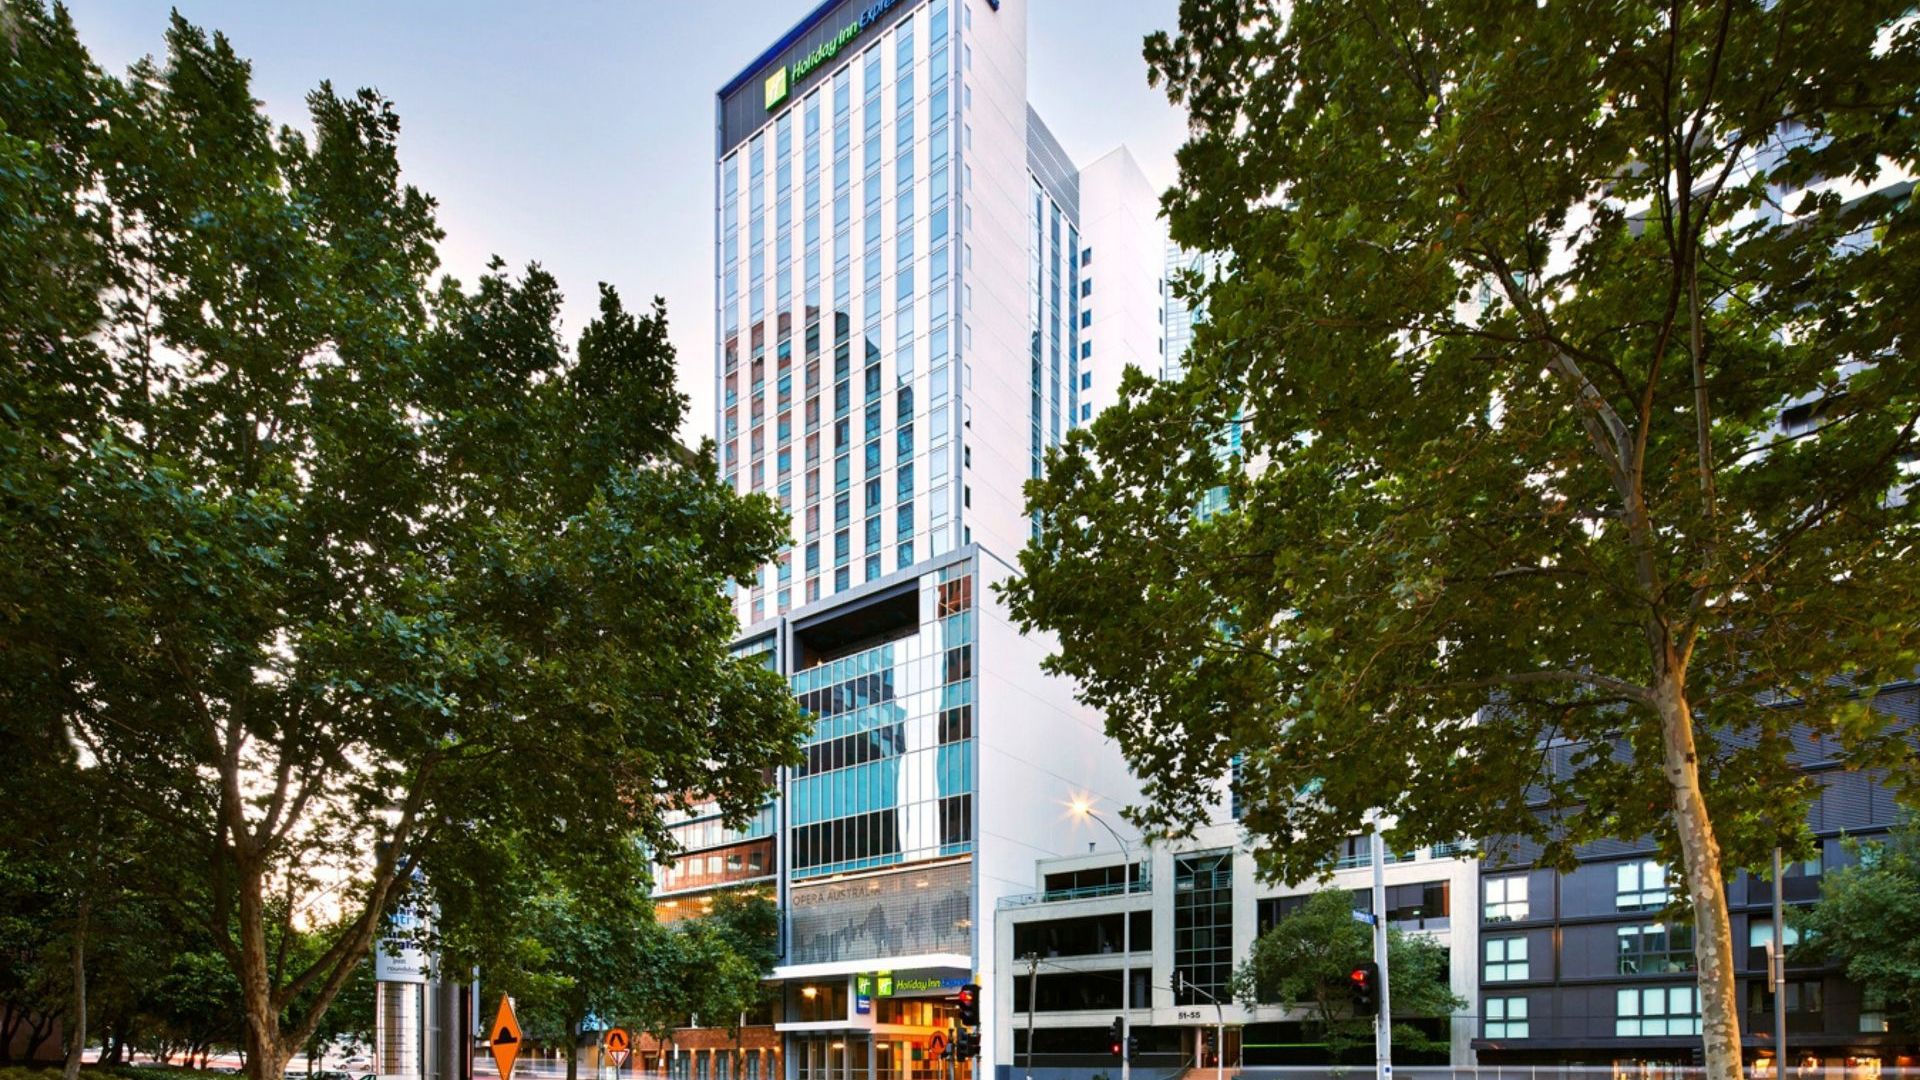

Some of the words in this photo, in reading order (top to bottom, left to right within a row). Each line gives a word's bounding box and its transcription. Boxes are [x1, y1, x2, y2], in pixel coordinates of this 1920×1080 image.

[791, 37, 837, 81] Holiday
[838, 21, 858, 45] Inn
[792, 892, 824, 906] OPERA
[896, 979, 928, 991] Holiday
[928, 978, 940, 988] Inn
[1178, 1011, 1201, 1020] 51-55
